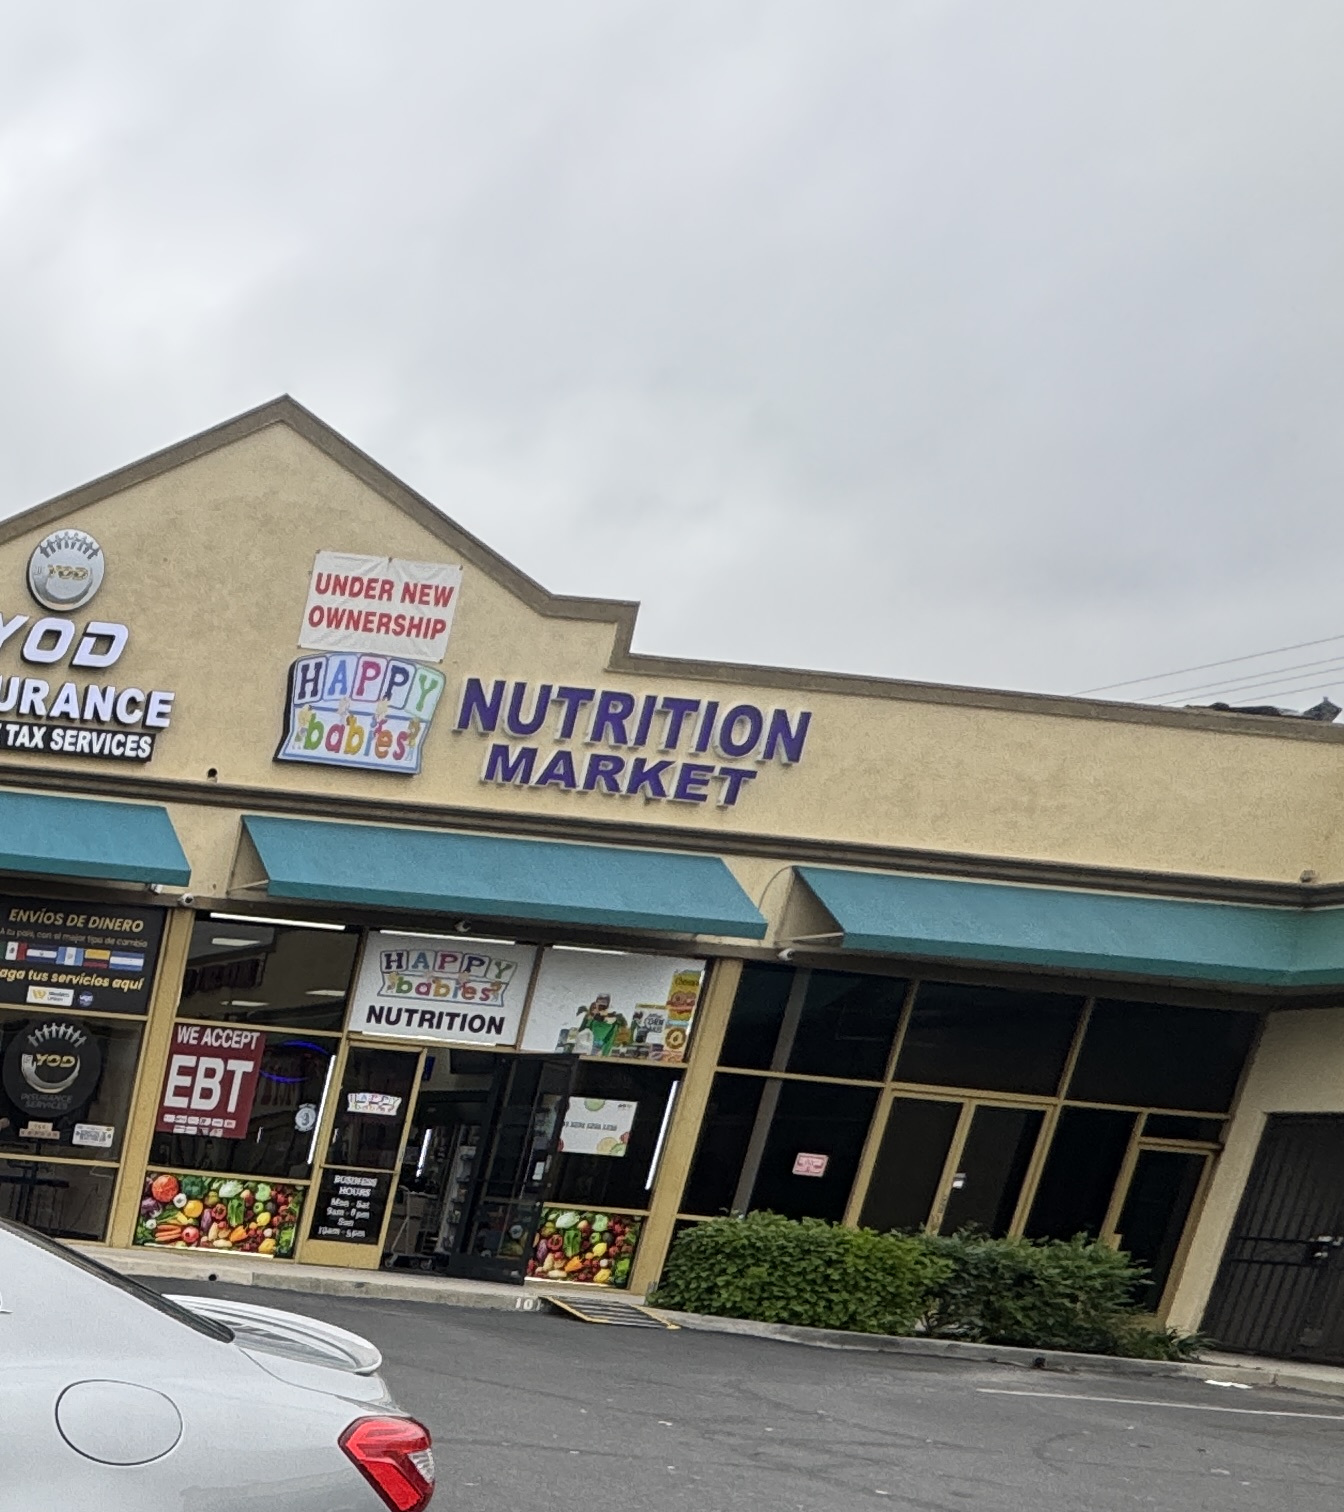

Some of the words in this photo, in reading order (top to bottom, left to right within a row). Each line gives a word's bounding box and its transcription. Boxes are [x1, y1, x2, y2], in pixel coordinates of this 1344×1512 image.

[315, 572, 394, 601] UNDER
[400, 582, 454, 608] NEW
[308, 605, 447, 640] OWNERSHIP
[298, 660, 439, 711] HAPPY
[304, 713, 408, 760] babies
[455, 677, 812, 764] NUTRITION
[6, 724, 47, 749] TAX
[50, 728, 153, 759] SERVICES
[482, 743, 758, 807] MARKET
[9, 908, 64, 926] ENVÍOS
[66, 914, 87, 928] DE
[88, 916, 144, 933] DINERO
[28, 969, 49, 982] tus
[112, 976, 145, 992] aquí
[384, 952, 512, 979] HAPPY
[396, 976, 492, 1002] babies
[177, 1025, 200, 1044] WE
[201, 1027, 260, 1050] ACCEPT
[366, 1005, 505, 1035] NUTRITION
[36, 1053, 76, 1068] YOD
[163, 1054, 255, 1113] EBT
